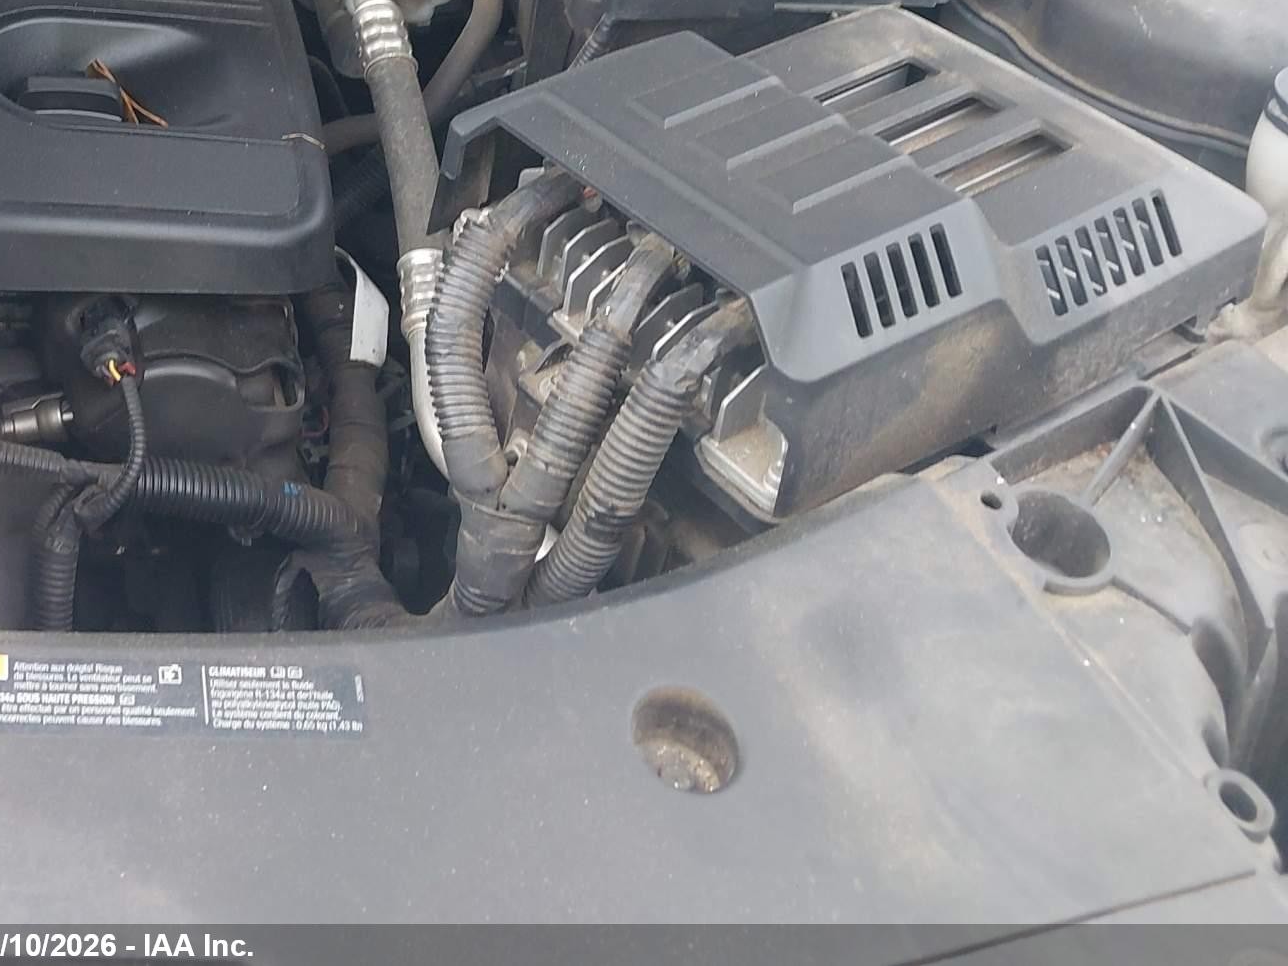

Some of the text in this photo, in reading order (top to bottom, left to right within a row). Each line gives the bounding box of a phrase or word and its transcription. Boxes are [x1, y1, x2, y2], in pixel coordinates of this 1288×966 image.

[208, 666, 266, 678] CLIMATISEUR
[16, 692, 40, 704] SOUS
[41, 693, 70, 704] HAUTE
[71, 694, 115, 705] PRESSION
